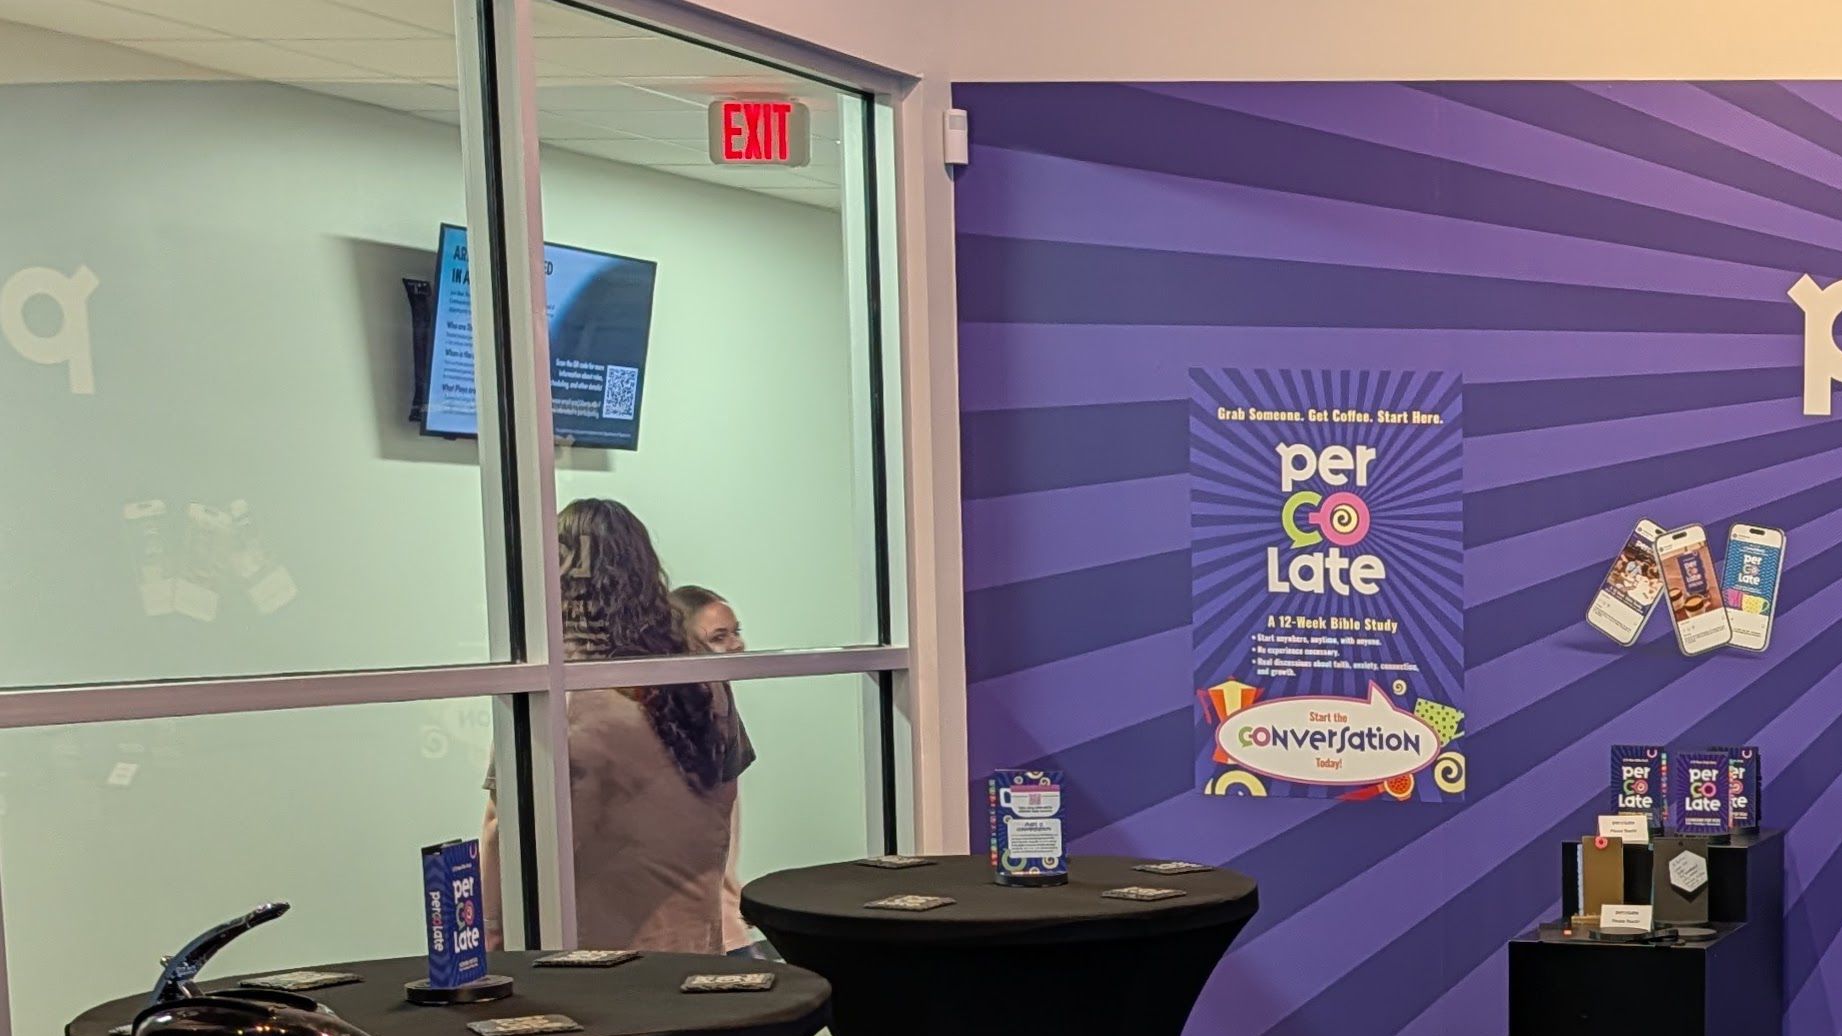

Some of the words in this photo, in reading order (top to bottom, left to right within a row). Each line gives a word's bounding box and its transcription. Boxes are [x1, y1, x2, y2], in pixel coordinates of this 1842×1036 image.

[723, 103, 792, 162] EXIT
[1218, 407, 1245, 420] Grab
[1249, 408, 1304, 421] Someone.
[1308, 409, 1328, 421] Get
[1332, 410, 1373, 422] Coffee.
[1378, 411, 1408, 423] Start
[1413, 412, 1443, 424] Here.
[1275, 442, 1376, 491] per
[1267, 546, 1385, 596] Late
[1268, 615, 1275, 628] A
[1279, 616, 1326, 629] 12-Week
[1331, 617, 1360, 630] Bible
[1365, 619, 1397, 633] Study
[1309, 712, 1332, 722] Start
[1334, 713, 1347, 722] the
[1316, 758, 1342, 769] Today!
[1622, 766, 1651, 780] per
[1689, 768, 1719, 782] per
[452, 876, 474, 904] per
